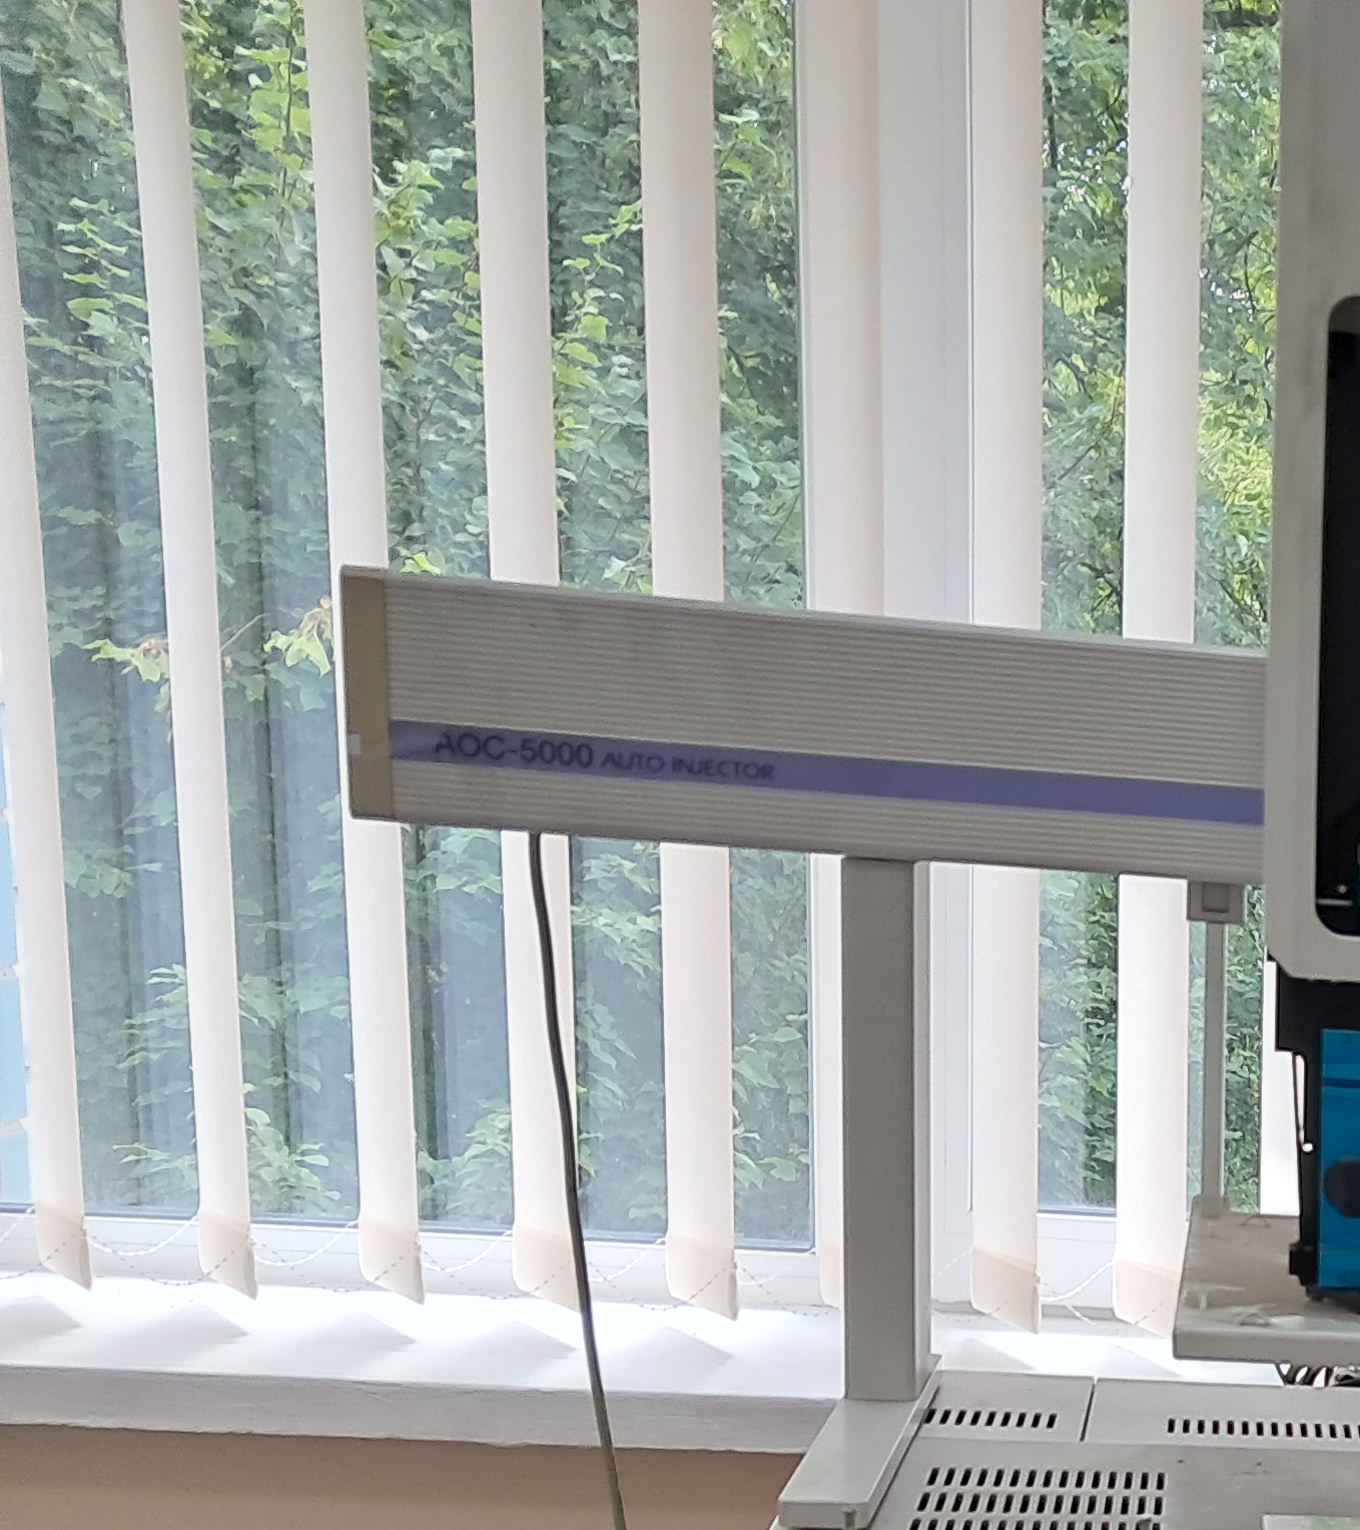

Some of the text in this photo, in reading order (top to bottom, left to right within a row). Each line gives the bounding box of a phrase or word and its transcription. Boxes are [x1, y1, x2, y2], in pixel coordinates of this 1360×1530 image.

[435, 732, 775, 780] AOC-5000 AUTO INJECTOR
